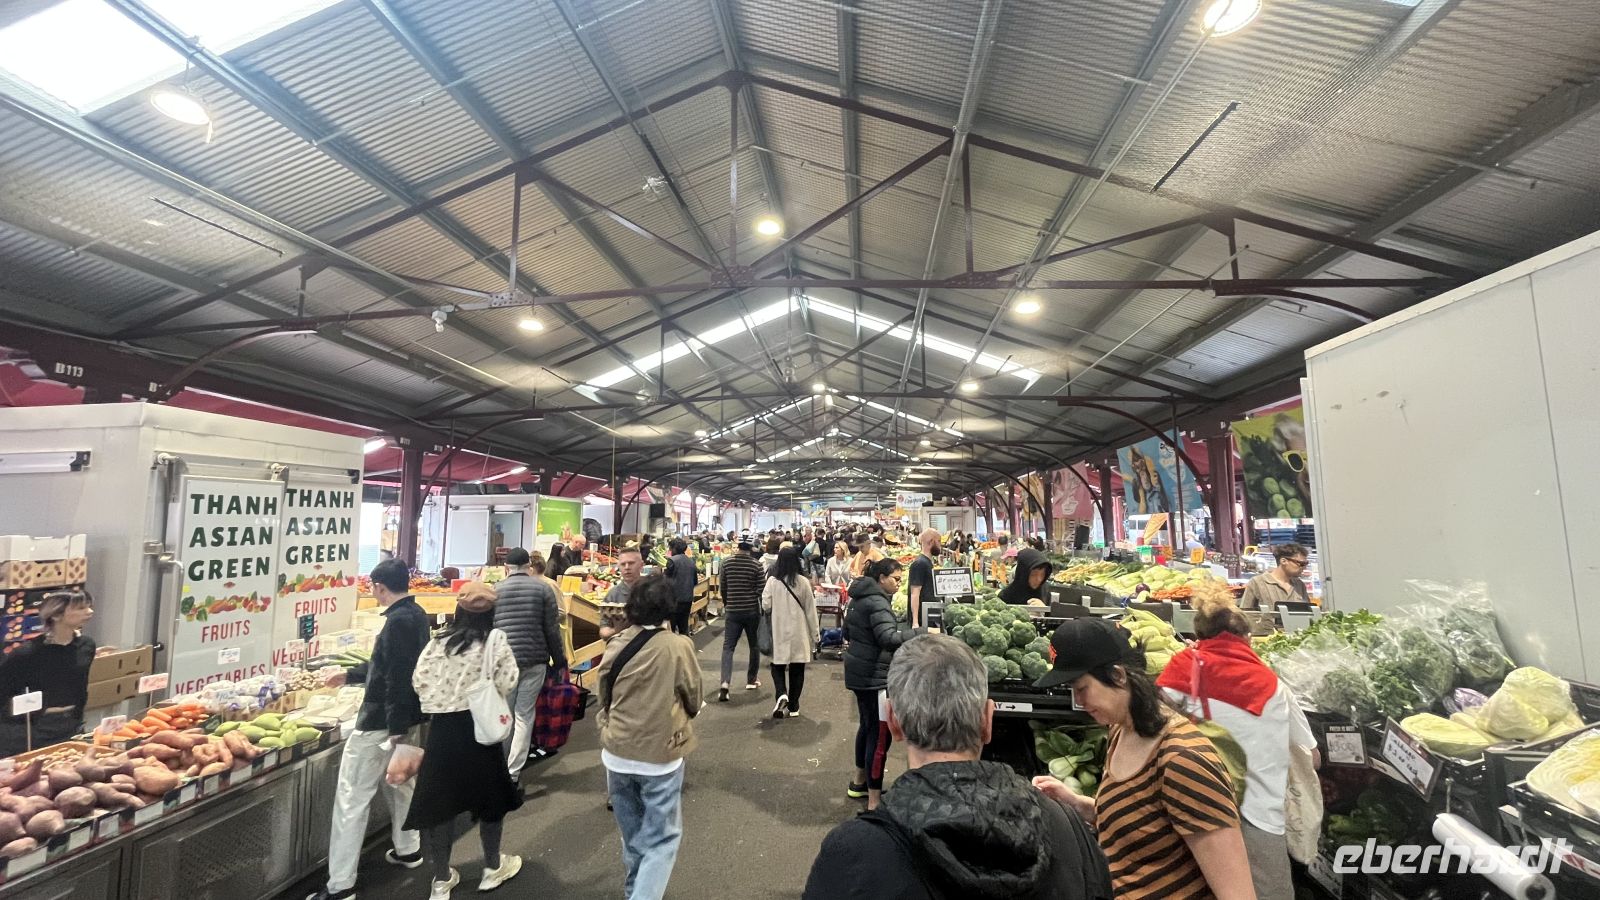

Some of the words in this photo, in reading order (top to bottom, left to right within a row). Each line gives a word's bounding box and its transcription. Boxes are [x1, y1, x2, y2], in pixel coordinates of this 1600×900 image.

[55, 362, 84, 378] B113
[190, 493, 278, 515] THANH
[286, 488, 354, 508] THANH
[189, 526, 274, 548] ASIAN
[285, 517, 352, 536] ASIAN
[285, 544, 350, 565] GREEN
[188, 557, 270, 581] GREEN
[294, 597, 338, 618] FRUITS
[201, 620, 251, 643] FRUITS
